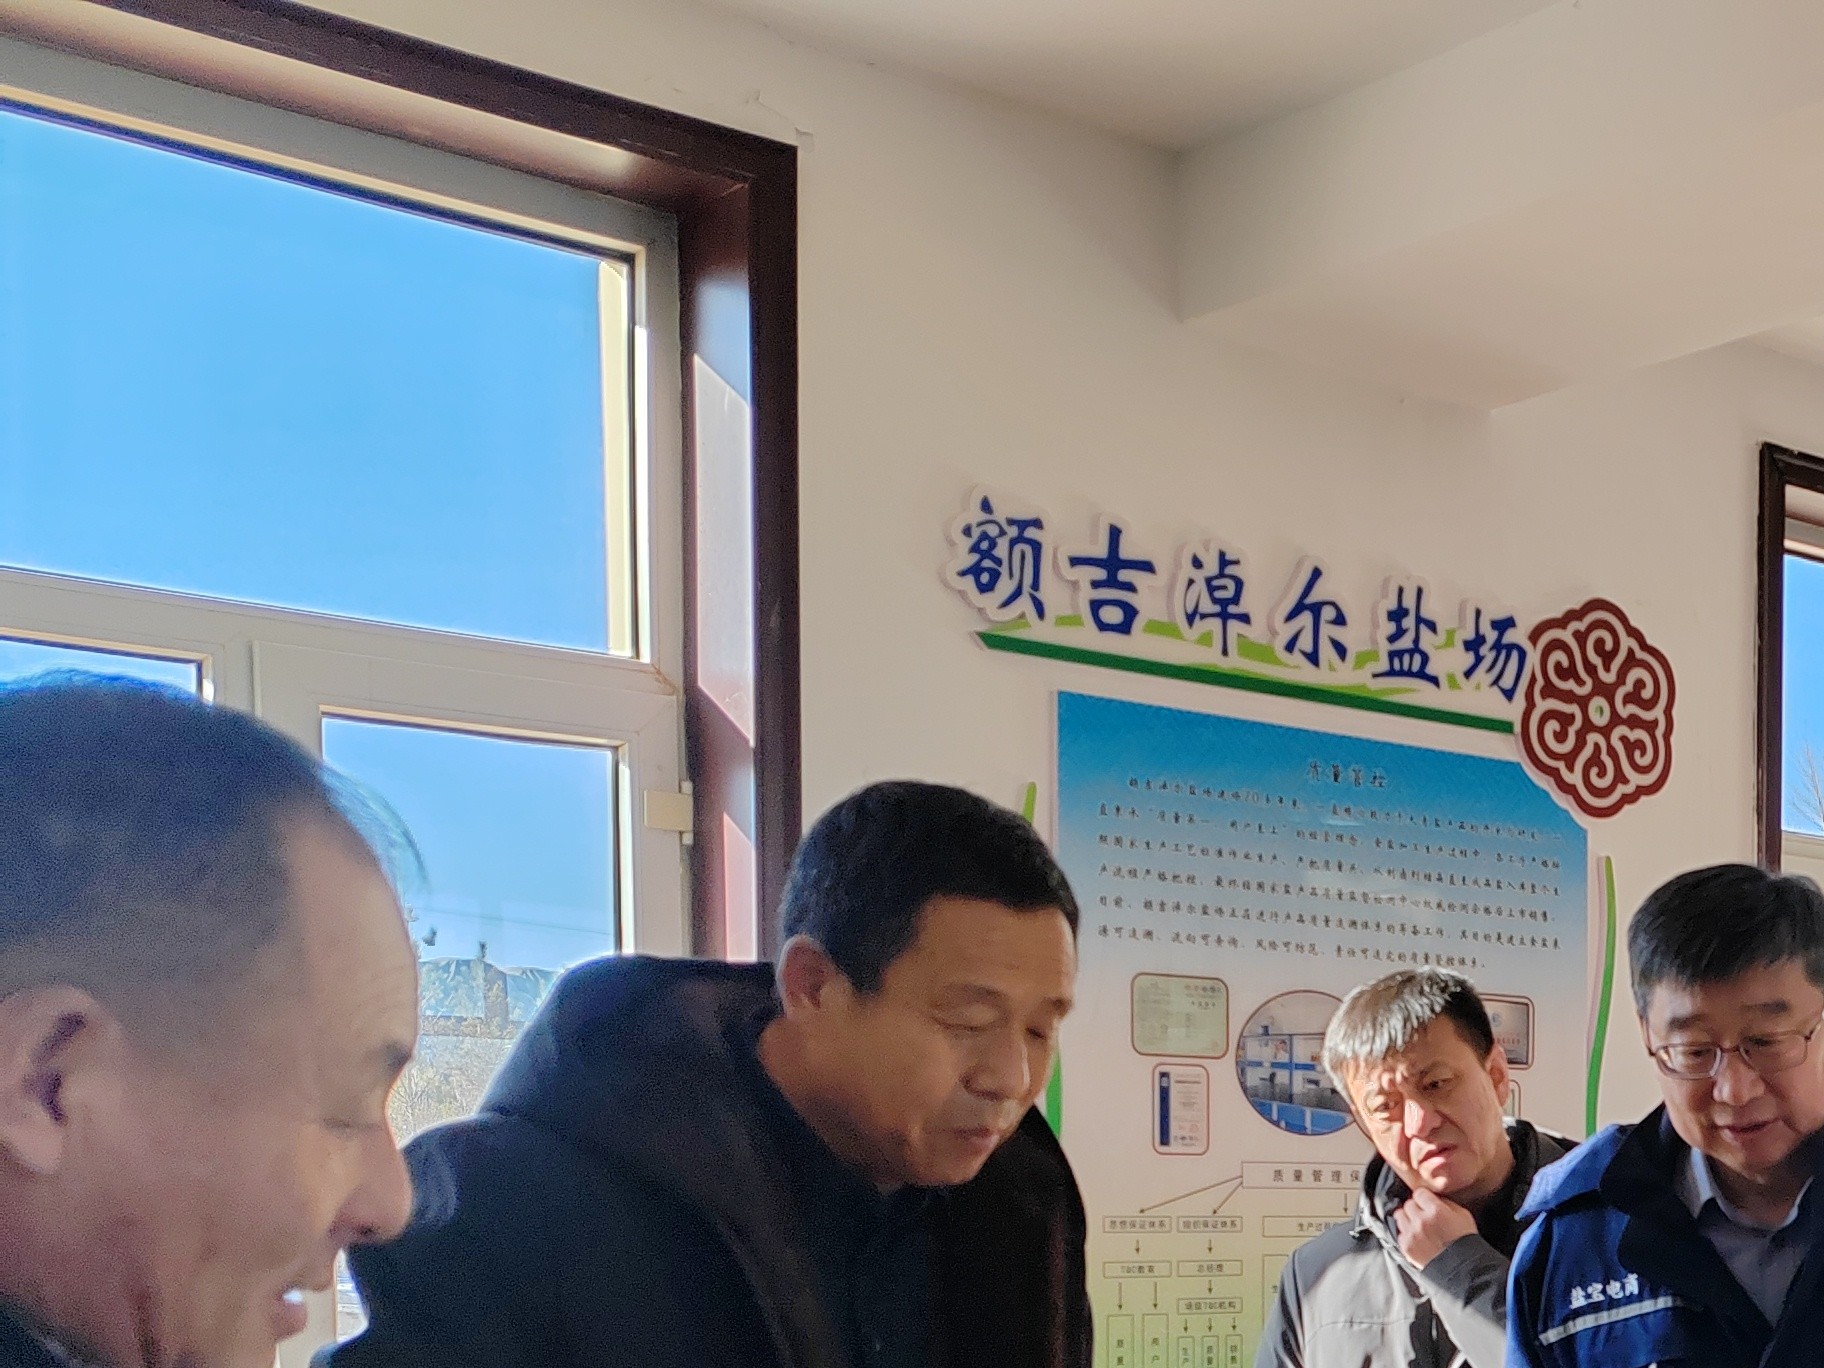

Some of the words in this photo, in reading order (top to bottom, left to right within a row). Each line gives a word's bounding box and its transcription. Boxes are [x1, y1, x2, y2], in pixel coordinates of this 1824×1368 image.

[957, 496, 1527, 703] 额吉淖尔盐场
[1272, 1168, 1361, 1183] 质量管理保
